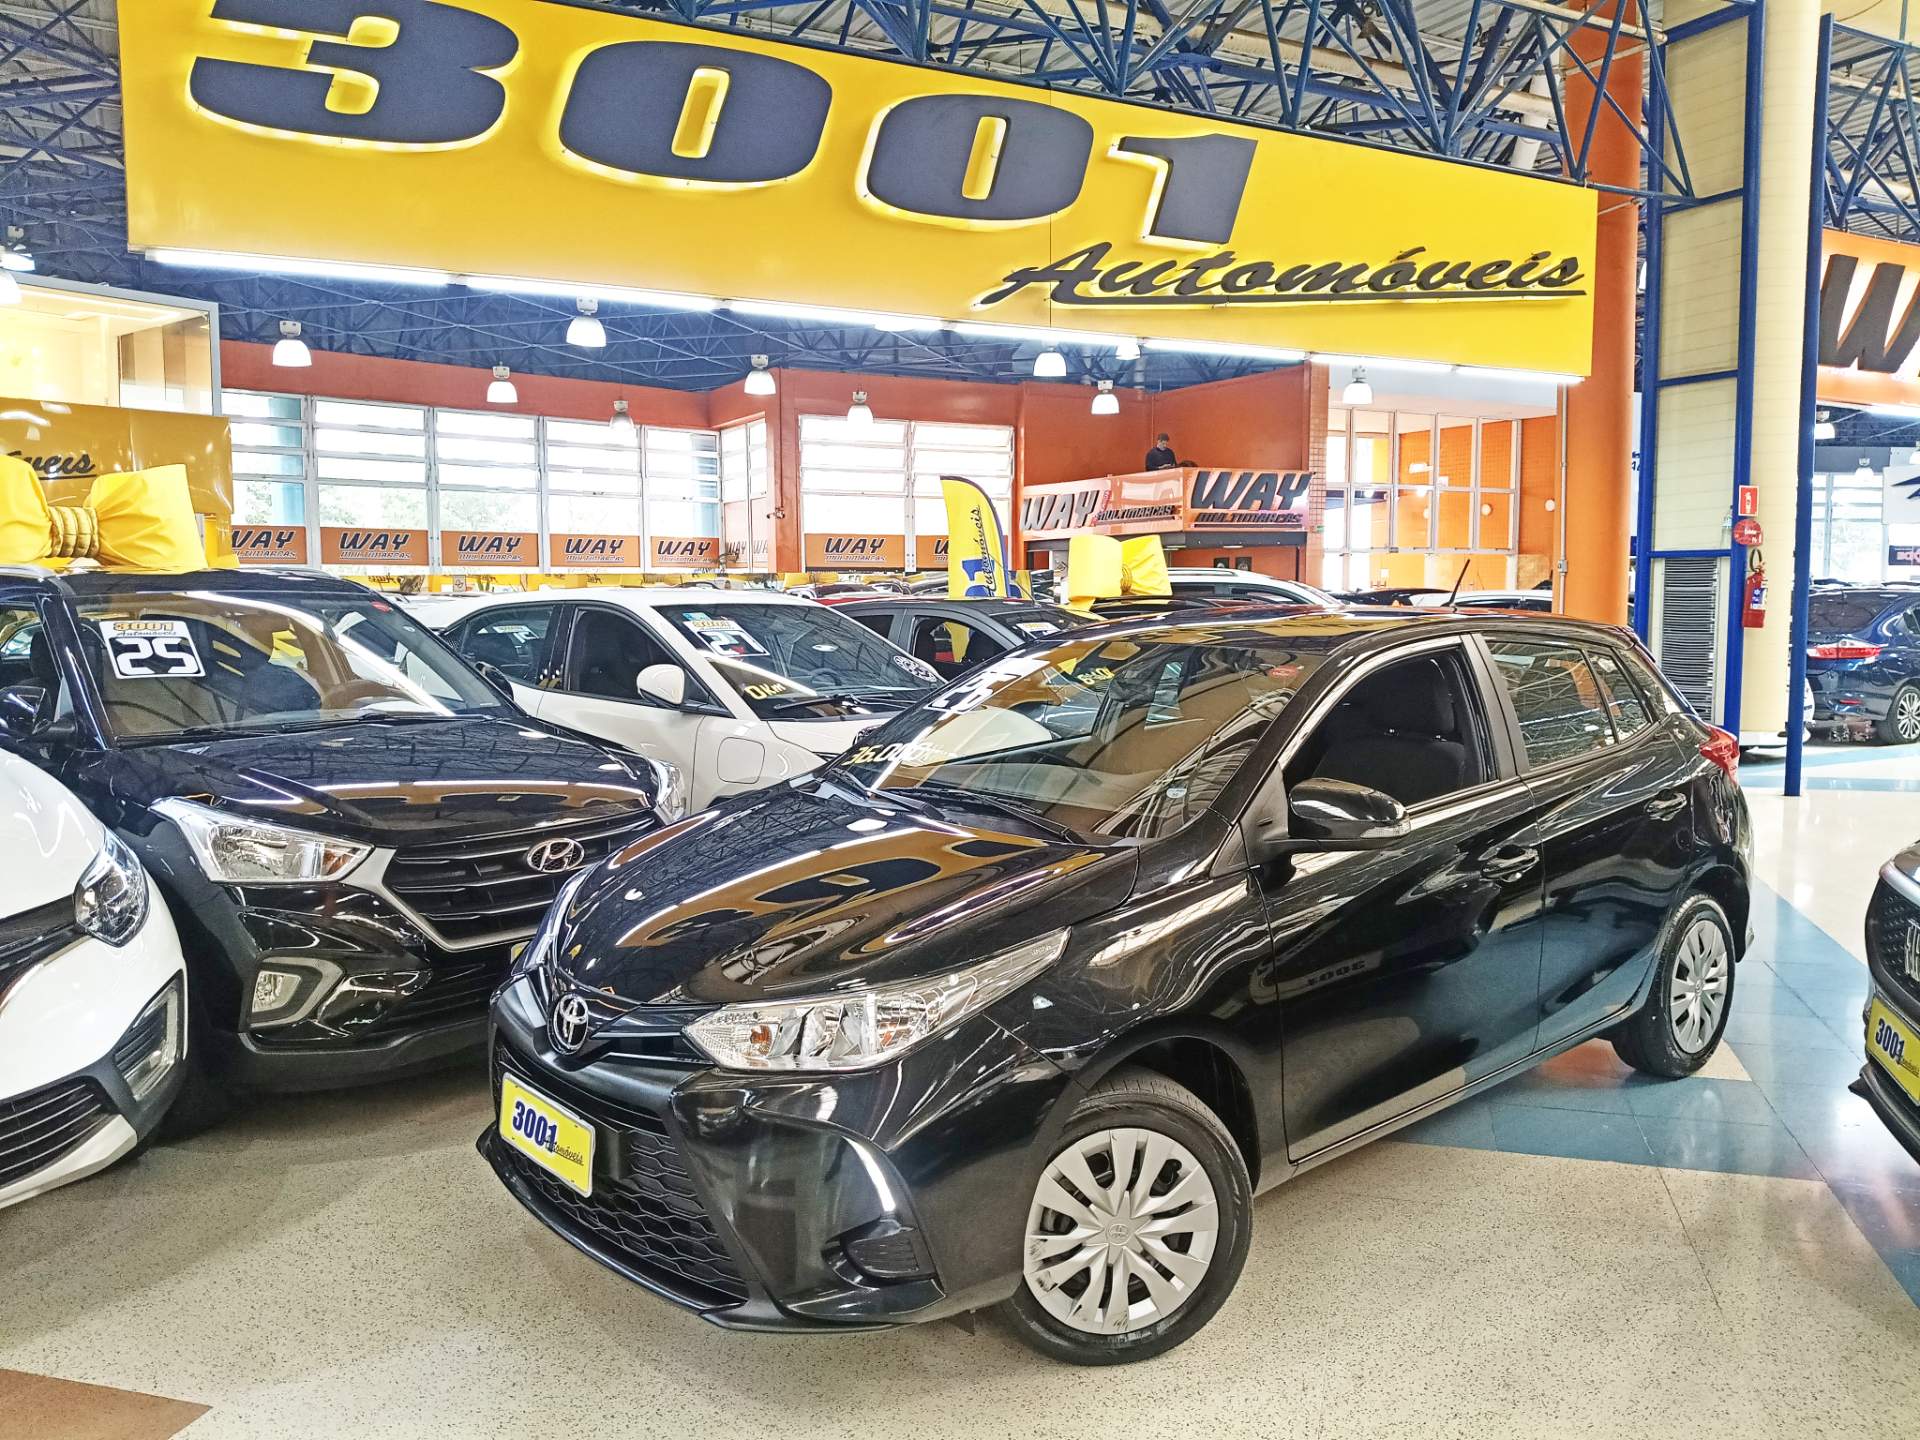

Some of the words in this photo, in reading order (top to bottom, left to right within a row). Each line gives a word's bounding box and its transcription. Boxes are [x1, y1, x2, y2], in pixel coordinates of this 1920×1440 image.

[190, 0, 1257, 248] 3001
[974, 241, 1587, 307] Automóveis
[1819, 253, 1920, 374] W
[1020, 489, 1100, 531] WAY
[1189, 470, 1313, 511] WAY
[1195, 512, 1304, 524] MULTIMARCAS
[339, 532, 410, 551] WAY
[457, 535, 523, 553] WAY
[565, 538, 625, 555] WAY
[657, 540, 712, 556] WAY
[823, 537, 885, 554] WAY
[114, 637, 199, 676] 25
[1875, 1017, 1905, 1064] 3001
[512, 1100, 557, 1153] 3001
